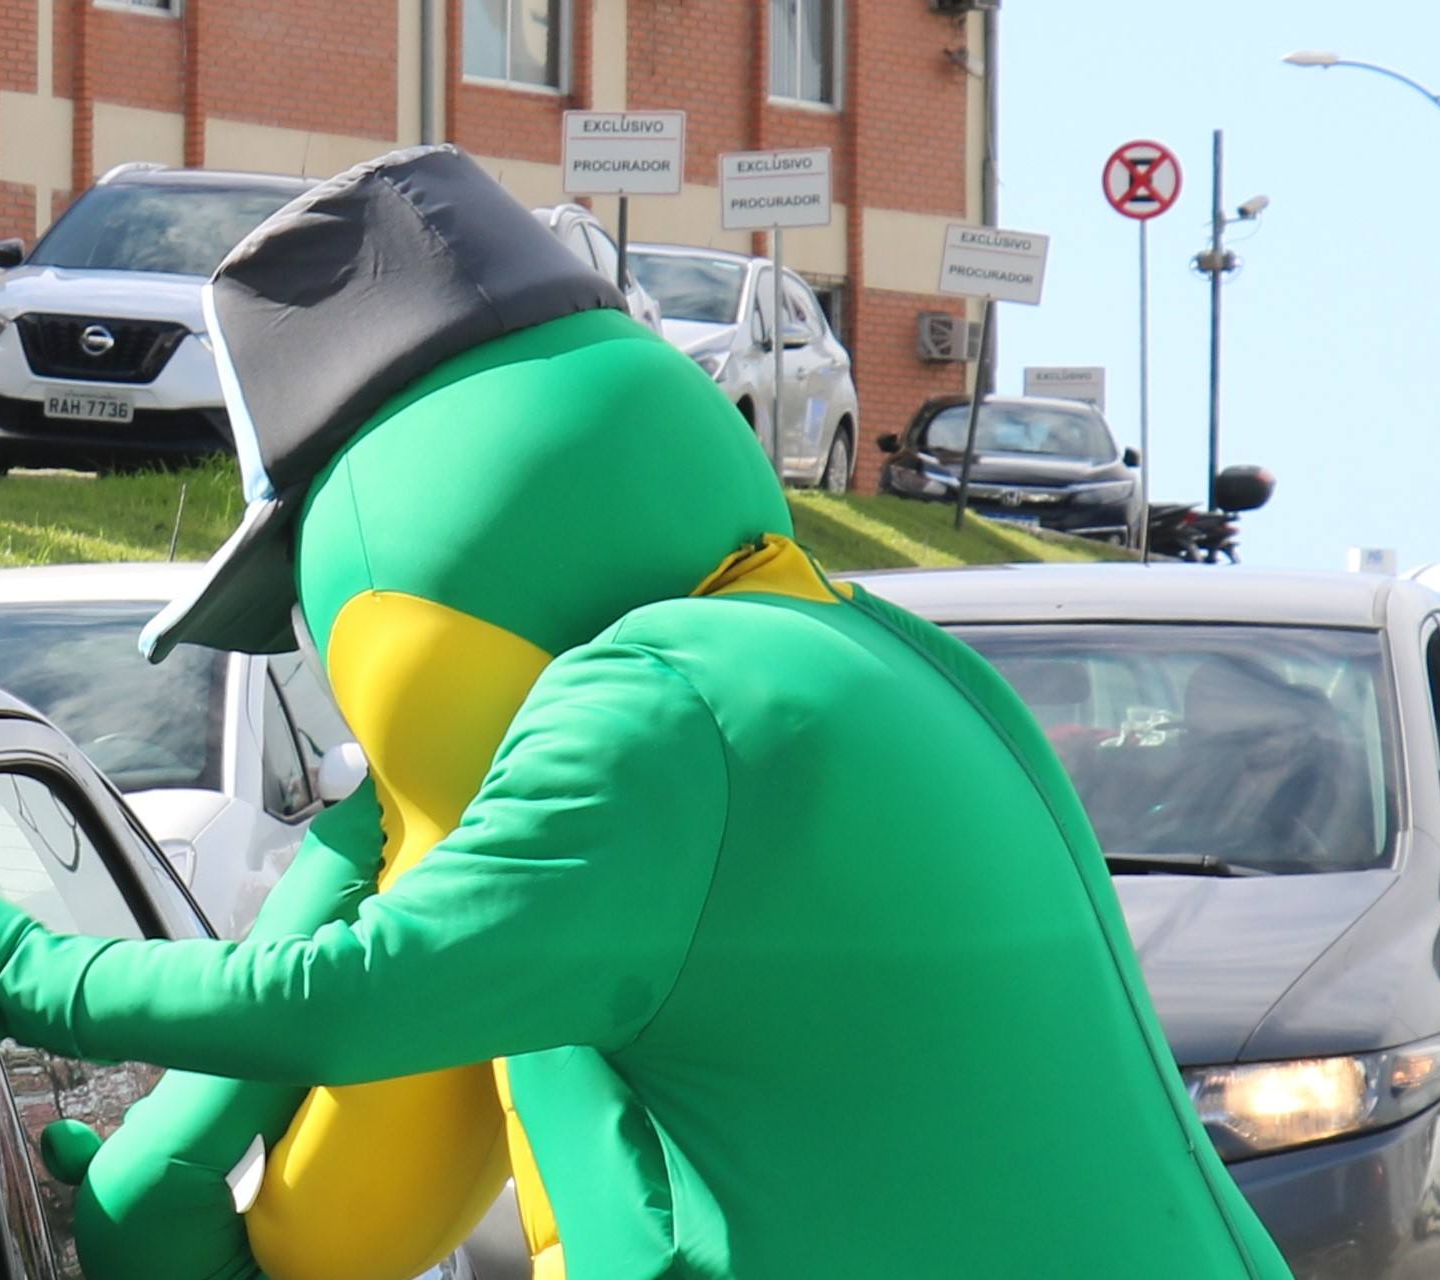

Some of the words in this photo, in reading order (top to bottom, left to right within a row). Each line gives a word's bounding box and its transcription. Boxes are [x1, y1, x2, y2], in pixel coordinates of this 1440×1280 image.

[582, 118, 664, 133] EXCLUSIVO
[572, 159, 671, 172] PROCURADOR
[736, 157, 813, 173] EXCLUSIVO
[730, 193, 821, 209] PROCURADOR
[960, 231, 1032, 251] EXCLUSIVO
[948, 263, 1034, 284] PROCURADOR
[49, 397, 81, 415] RAH
[86, 400, 129, 419] 7736
